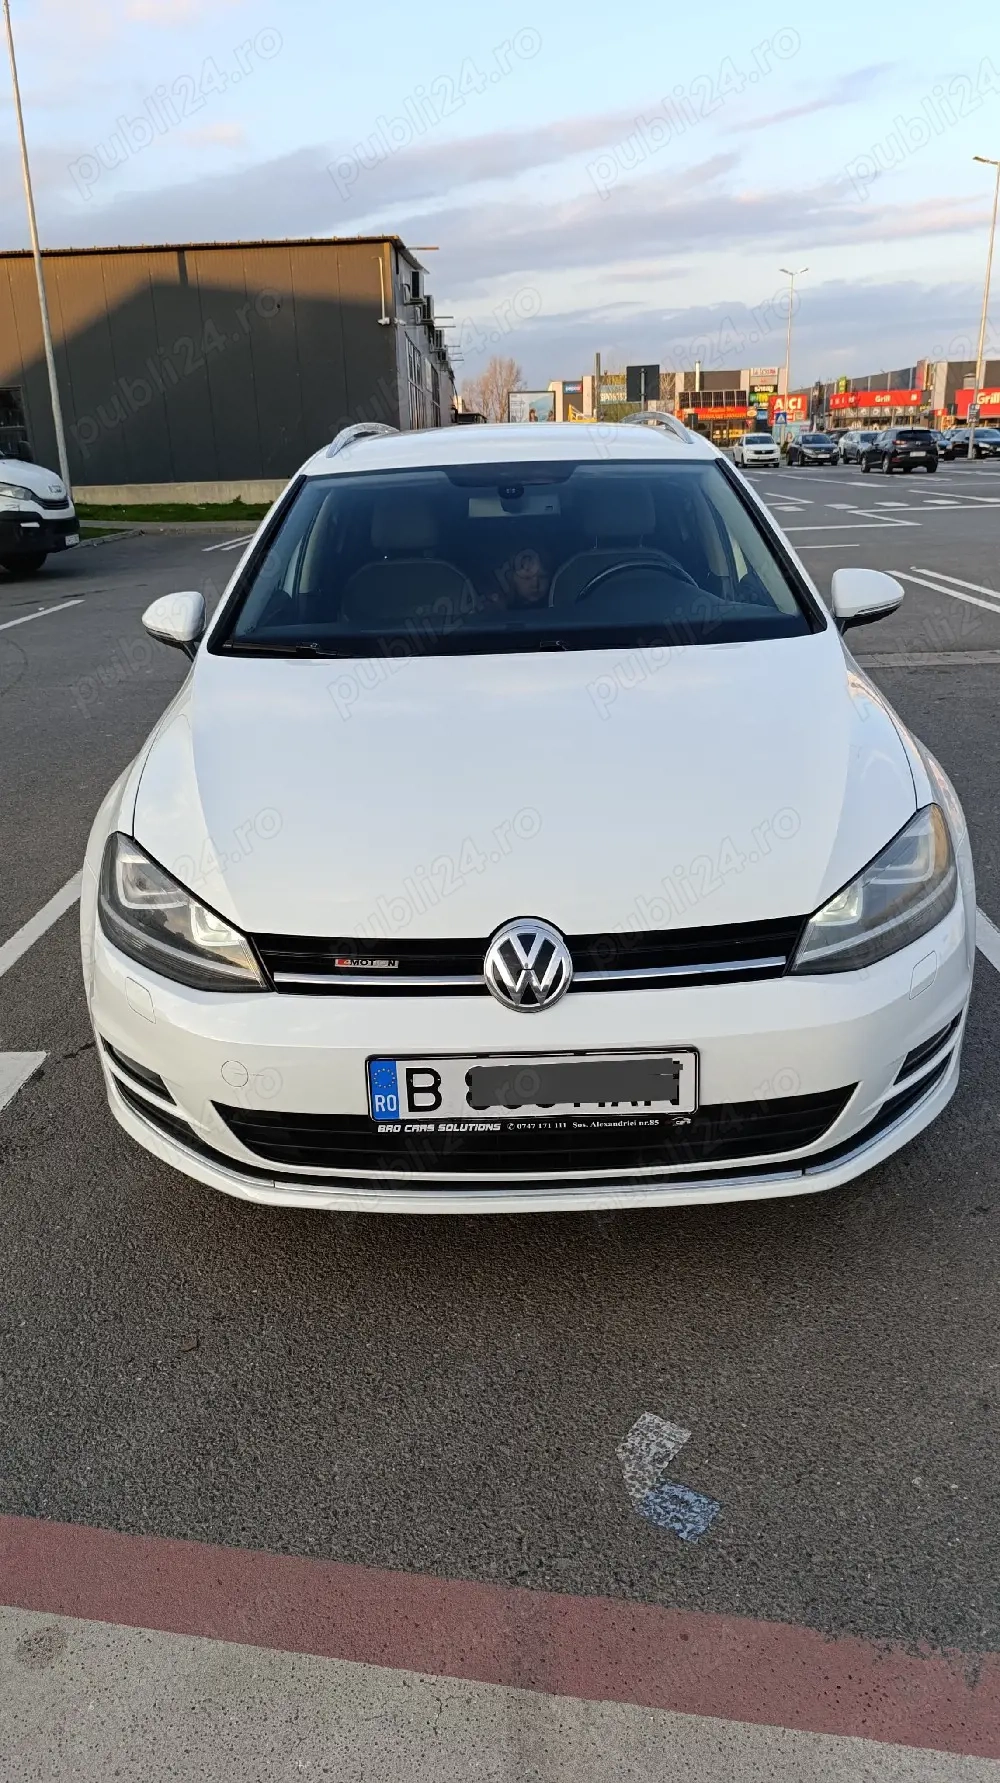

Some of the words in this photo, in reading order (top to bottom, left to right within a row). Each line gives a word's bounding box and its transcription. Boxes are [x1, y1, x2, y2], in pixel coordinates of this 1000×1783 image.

[875, 394, 891, 403] Grill
[340, 959, 395, 967] 4MOTN
[406, 1067, 442, 1112] B
[375, 1094, 397, 1112] RO
[438, 1123, 502, 1132] SOLUTIONS
[638, 1119, 660, 1127] nr.85
